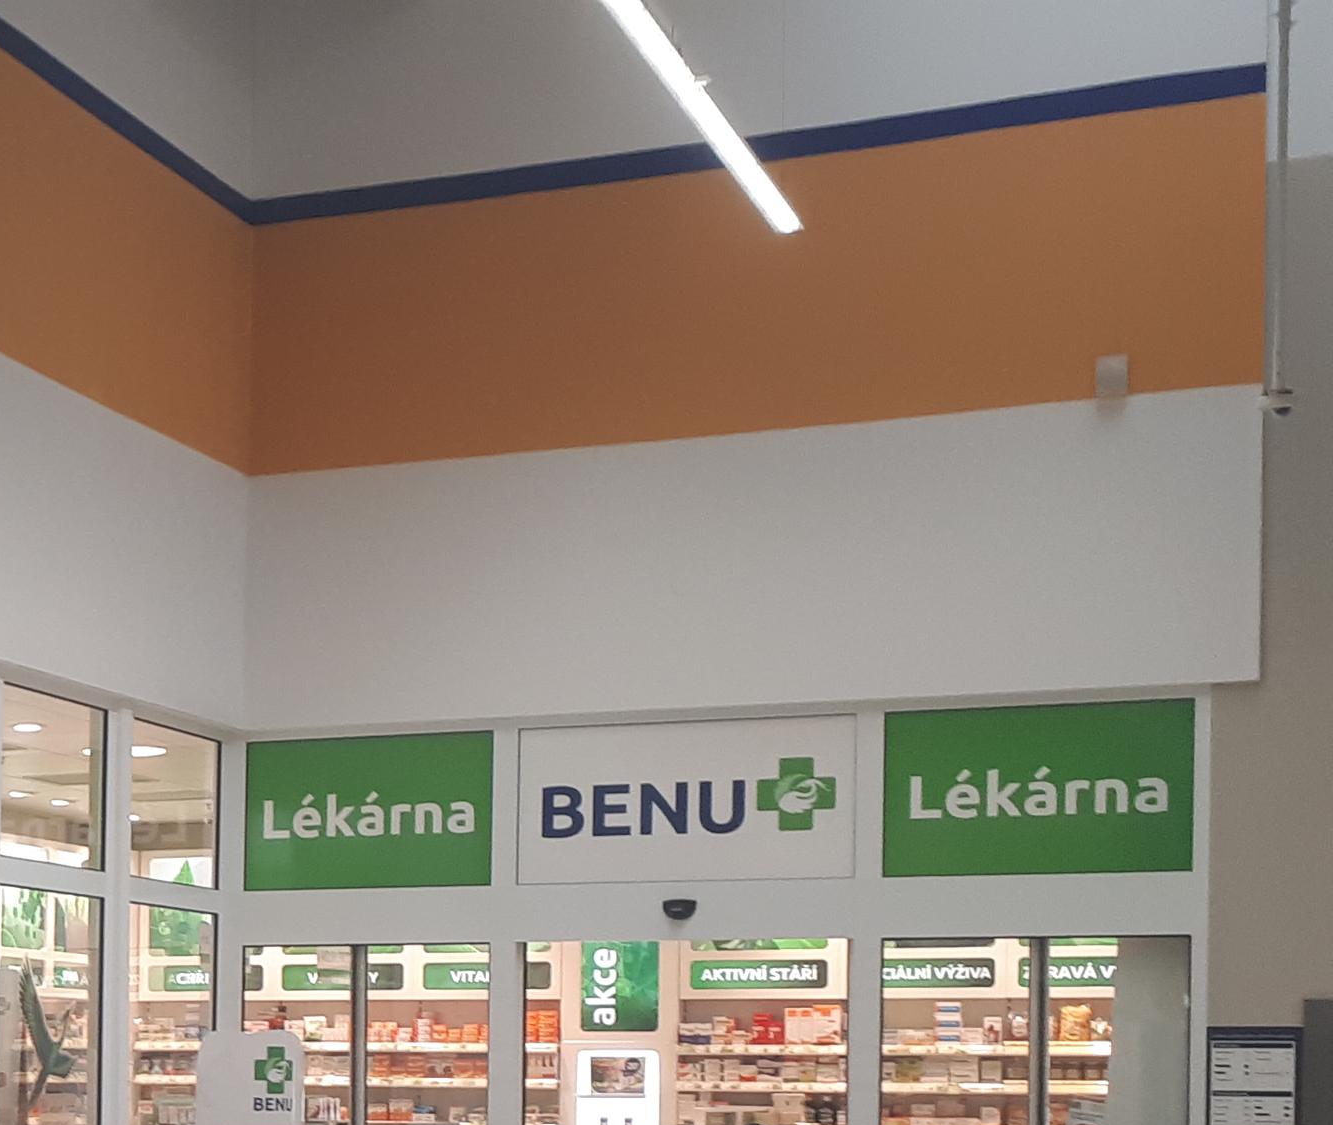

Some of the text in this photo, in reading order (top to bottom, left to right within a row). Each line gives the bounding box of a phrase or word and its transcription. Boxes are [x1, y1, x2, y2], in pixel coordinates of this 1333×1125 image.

[909, 766, 1170, 820] Lékárna
[263, 792, 476, 840] Lékárna
[541, 779, 747, 839] BENU
[449, 969, 490, 984] VITA
[700, 963, 819, 982] AKTIVNÍ STÁŘÍ
[881, 962, 993, 981] CIÁLNÍ VÝŽIVA
[1022, 961, 1099, 981] ZRAVÁ
[584, 946, 618, 1027] akce
[252, 1096, 294, 1112] BENU
